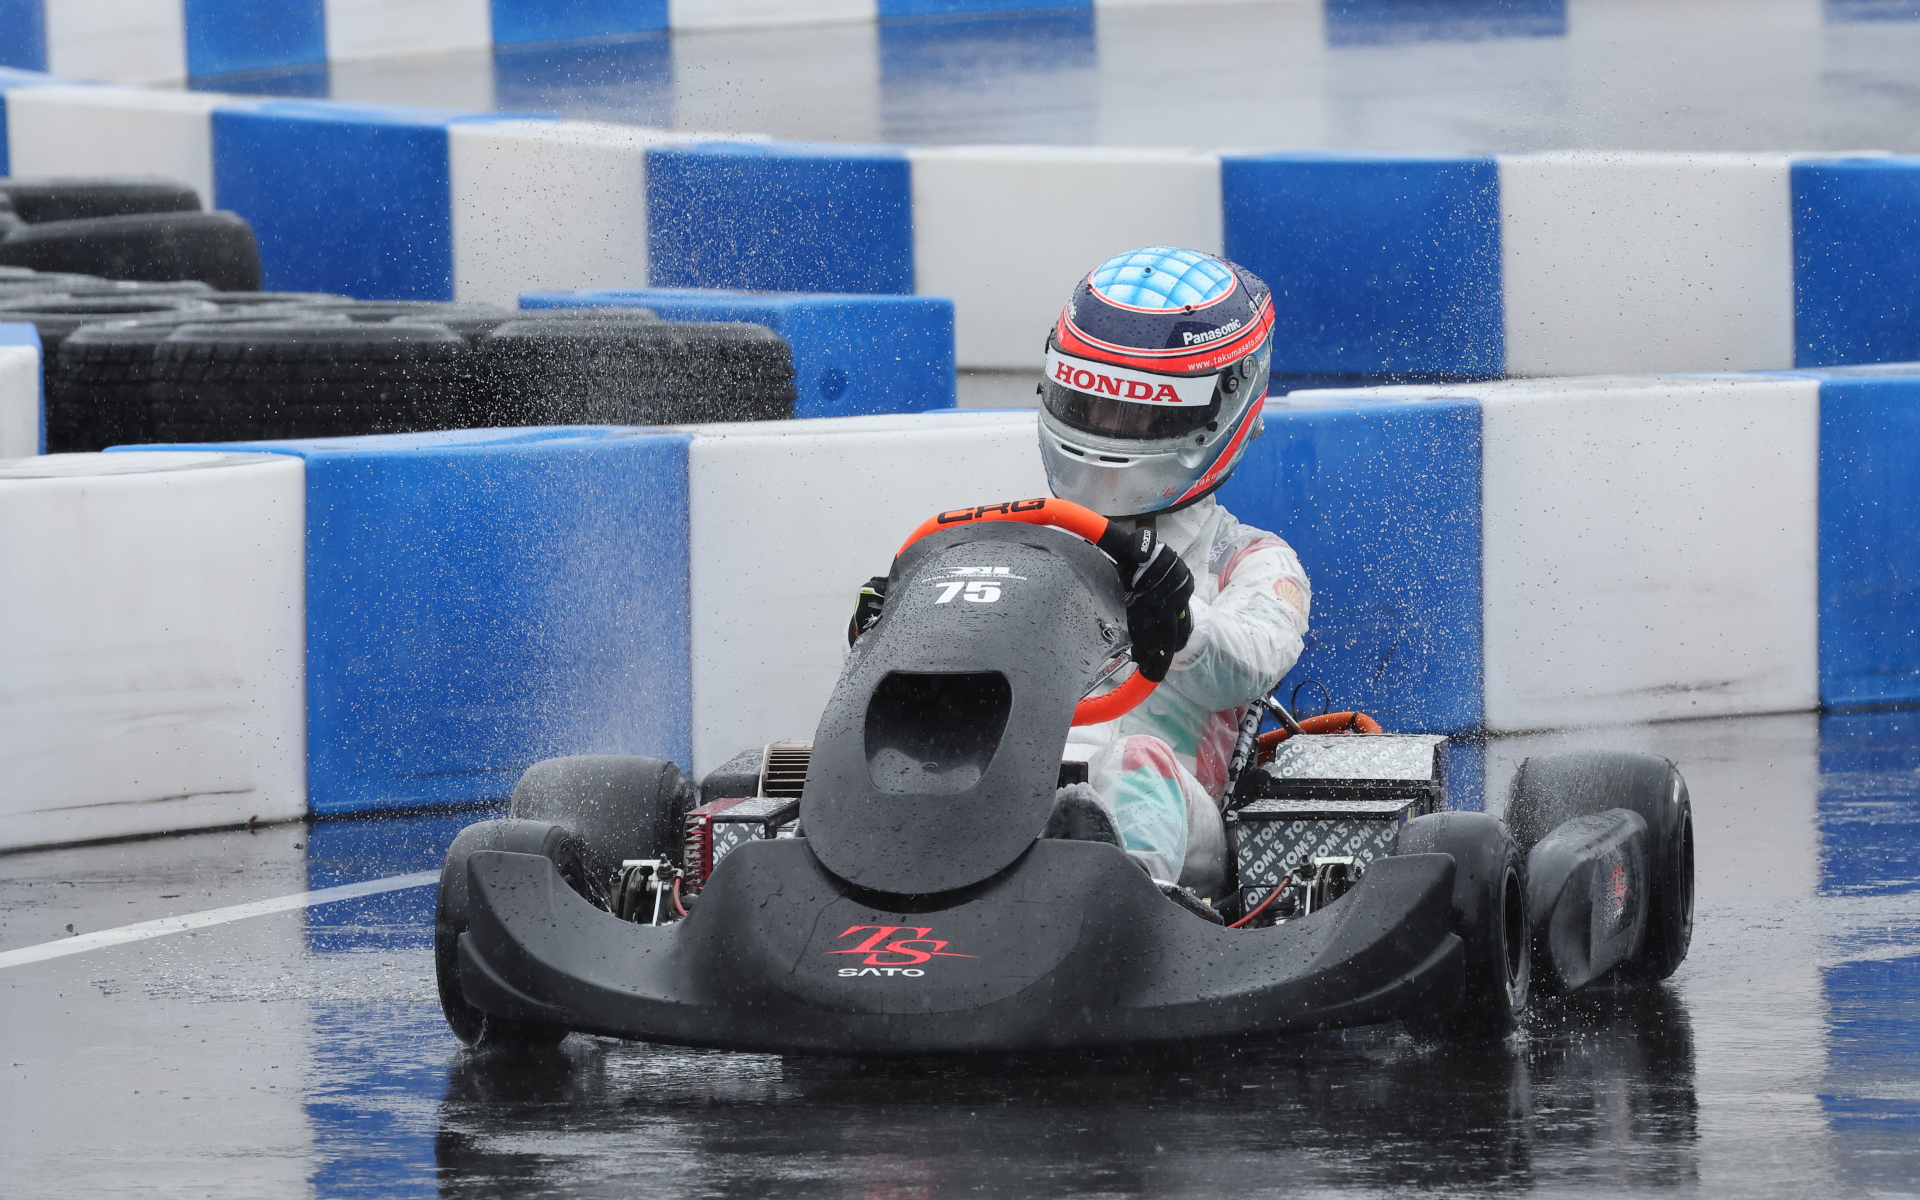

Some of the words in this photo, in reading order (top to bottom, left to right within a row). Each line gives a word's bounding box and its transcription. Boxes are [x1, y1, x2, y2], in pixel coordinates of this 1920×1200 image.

[1183, 319, 1241, 345] Panasonic
[1054, 361, 1182, 403] HONDA
[937, 498, 1046, 524] CRG
[934, 581, 1001, 604] 75
[1245, 839, 1285, 881] TOM'S
[1278, 830, 1317, 872] TOM'S
[830, 926, 960, 965] TS
[837, 967, 925, 977] SATO
